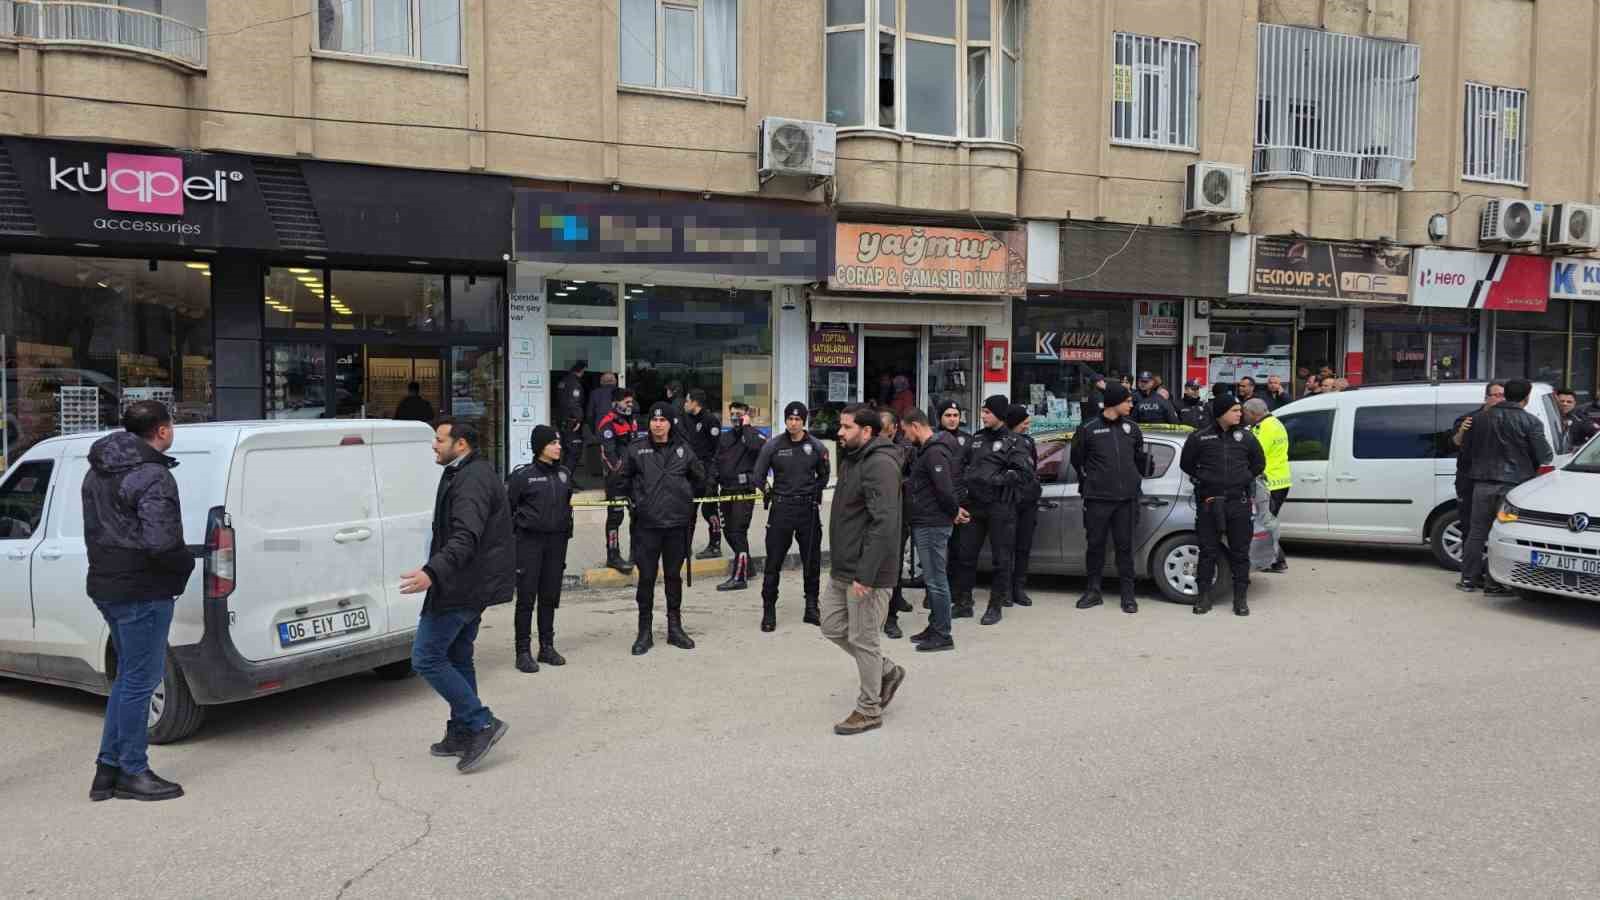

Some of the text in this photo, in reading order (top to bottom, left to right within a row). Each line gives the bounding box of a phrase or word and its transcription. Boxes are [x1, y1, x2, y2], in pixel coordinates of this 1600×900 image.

[93, 217, 201, 235] accessories
[857, 228, 1003, 265] yağmur
[1434, 271, 1466, 286] Hero
[1060, 331, 1104, 347] KAVALA
[1537, 553, 1551, 566] 27
[1556, 557, 1577, 570] AUT
[288, 623, 305, 640] 06
[312, 616, 334, 635] EIY
[343, 610, 367, 628] 029
